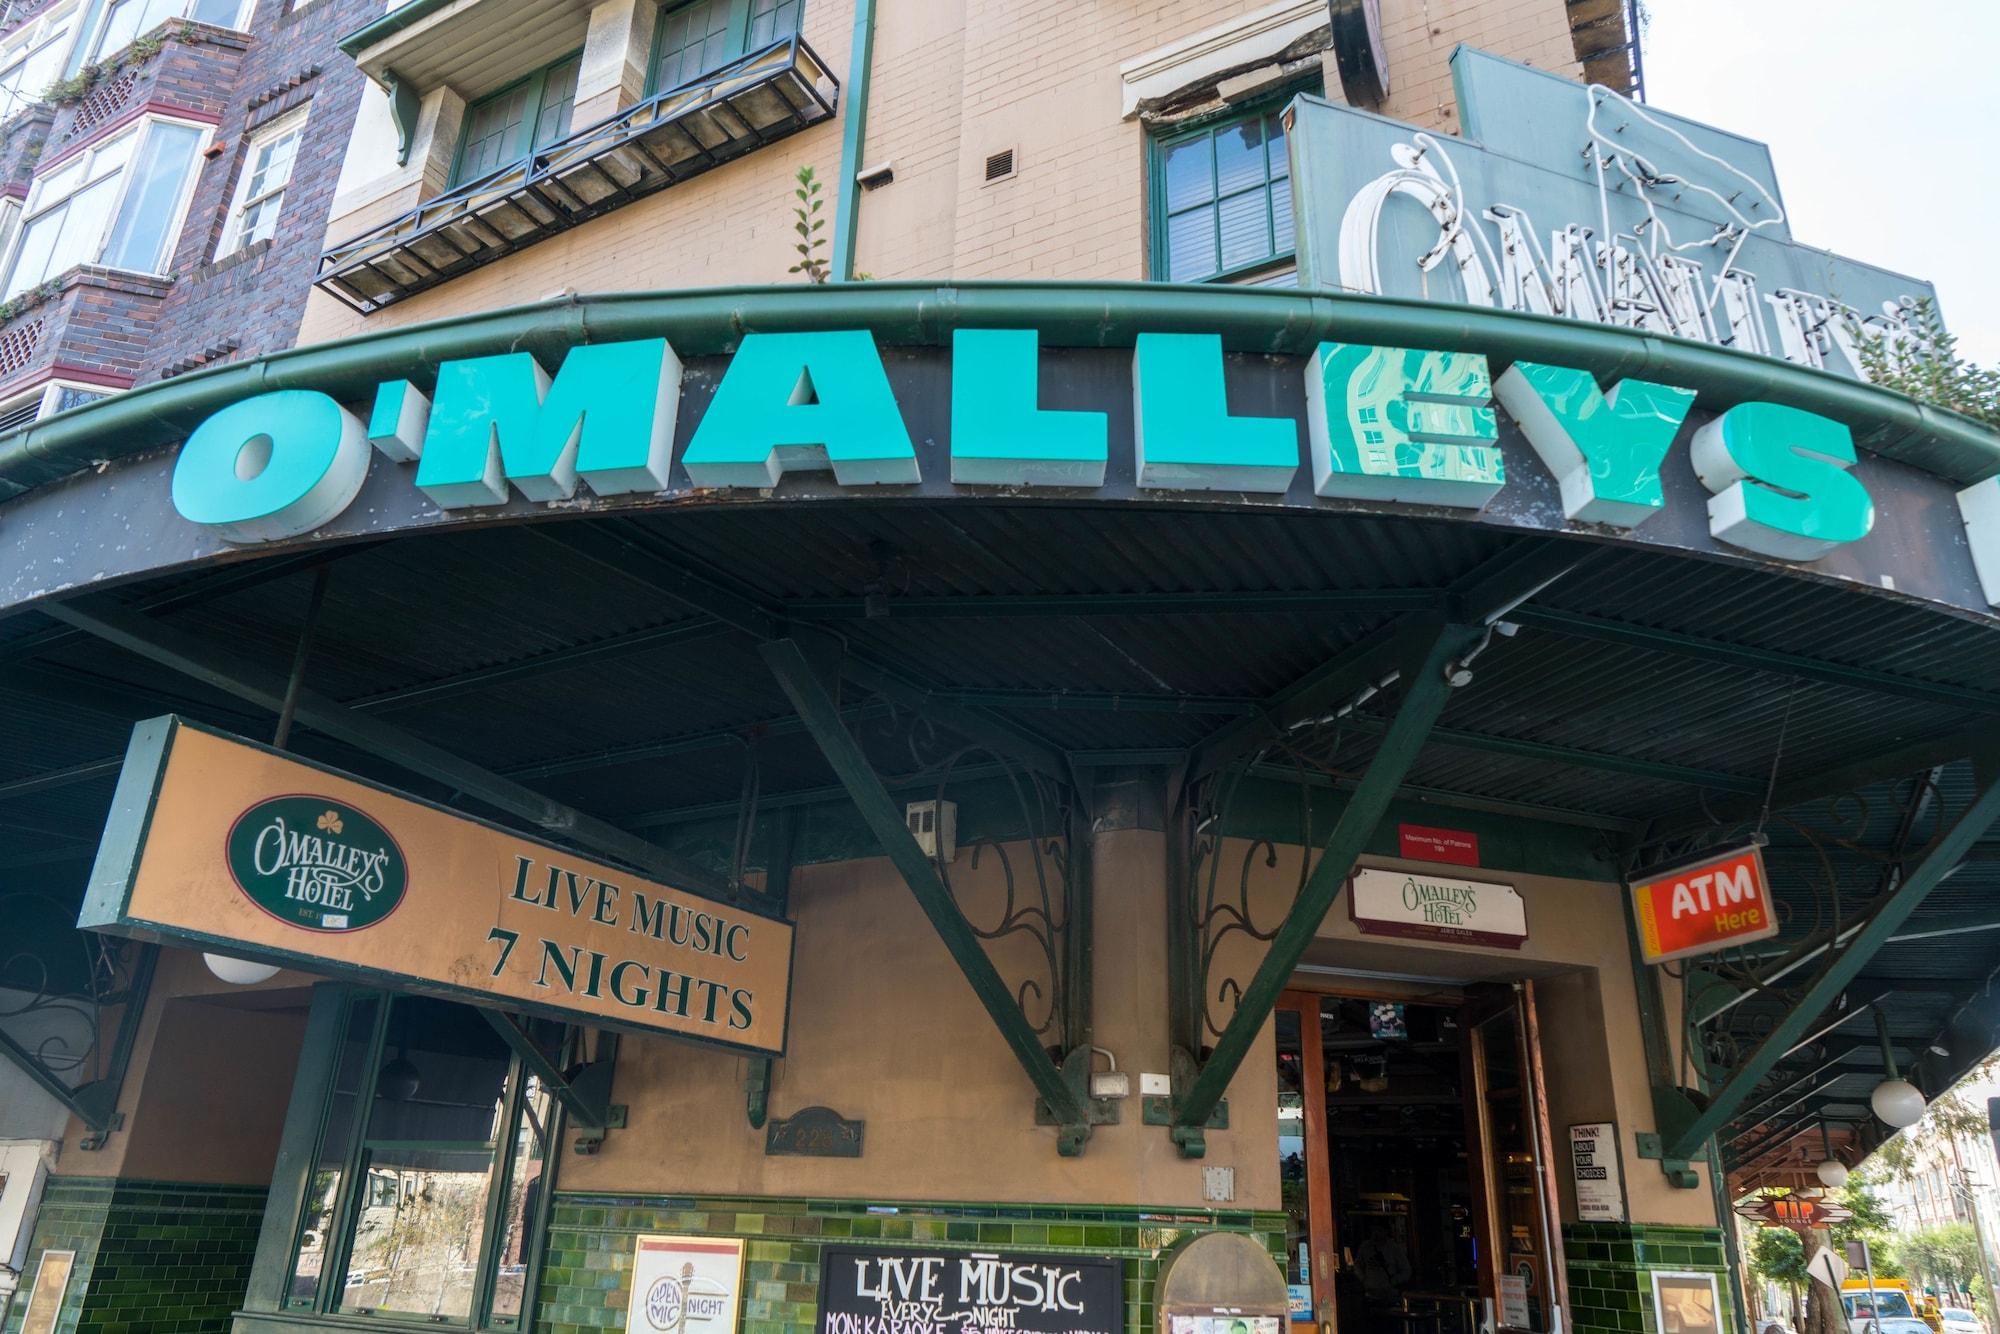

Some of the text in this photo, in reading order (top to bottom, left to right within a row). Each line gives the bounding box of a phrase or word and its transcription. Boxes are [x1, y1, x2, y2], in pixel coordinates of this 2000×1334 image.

[171, 327, 1876, 560] O'MALLEYS
[1672, 864, 1756, 919] ATM
[510, 856, 749, 962] LIVE MUSIC
[1715, 908, 1761, 933] Here
[488, 927, 753, 1030] 7 NIGHTS
[1573, 1127, 1600, 1138] THINK!
[1574, 1140, 1595, 1152] ABOUT
[1576, 1154, 1592, 1165] YOUR
[1577, 1168, 1606, 1179] CHOICES
[1773, 1201, 1813, 1218] VIP
[651, 1282, 680, 1304] OPEN
[855, 1257, 1084, 1314] LIVE MUSIC
[651, 1303, 680, 1324] MIC
[688, 1298, 725, 1316] NIGHT
[881, 1300, 1020, 1329] EVERY NIGHT
